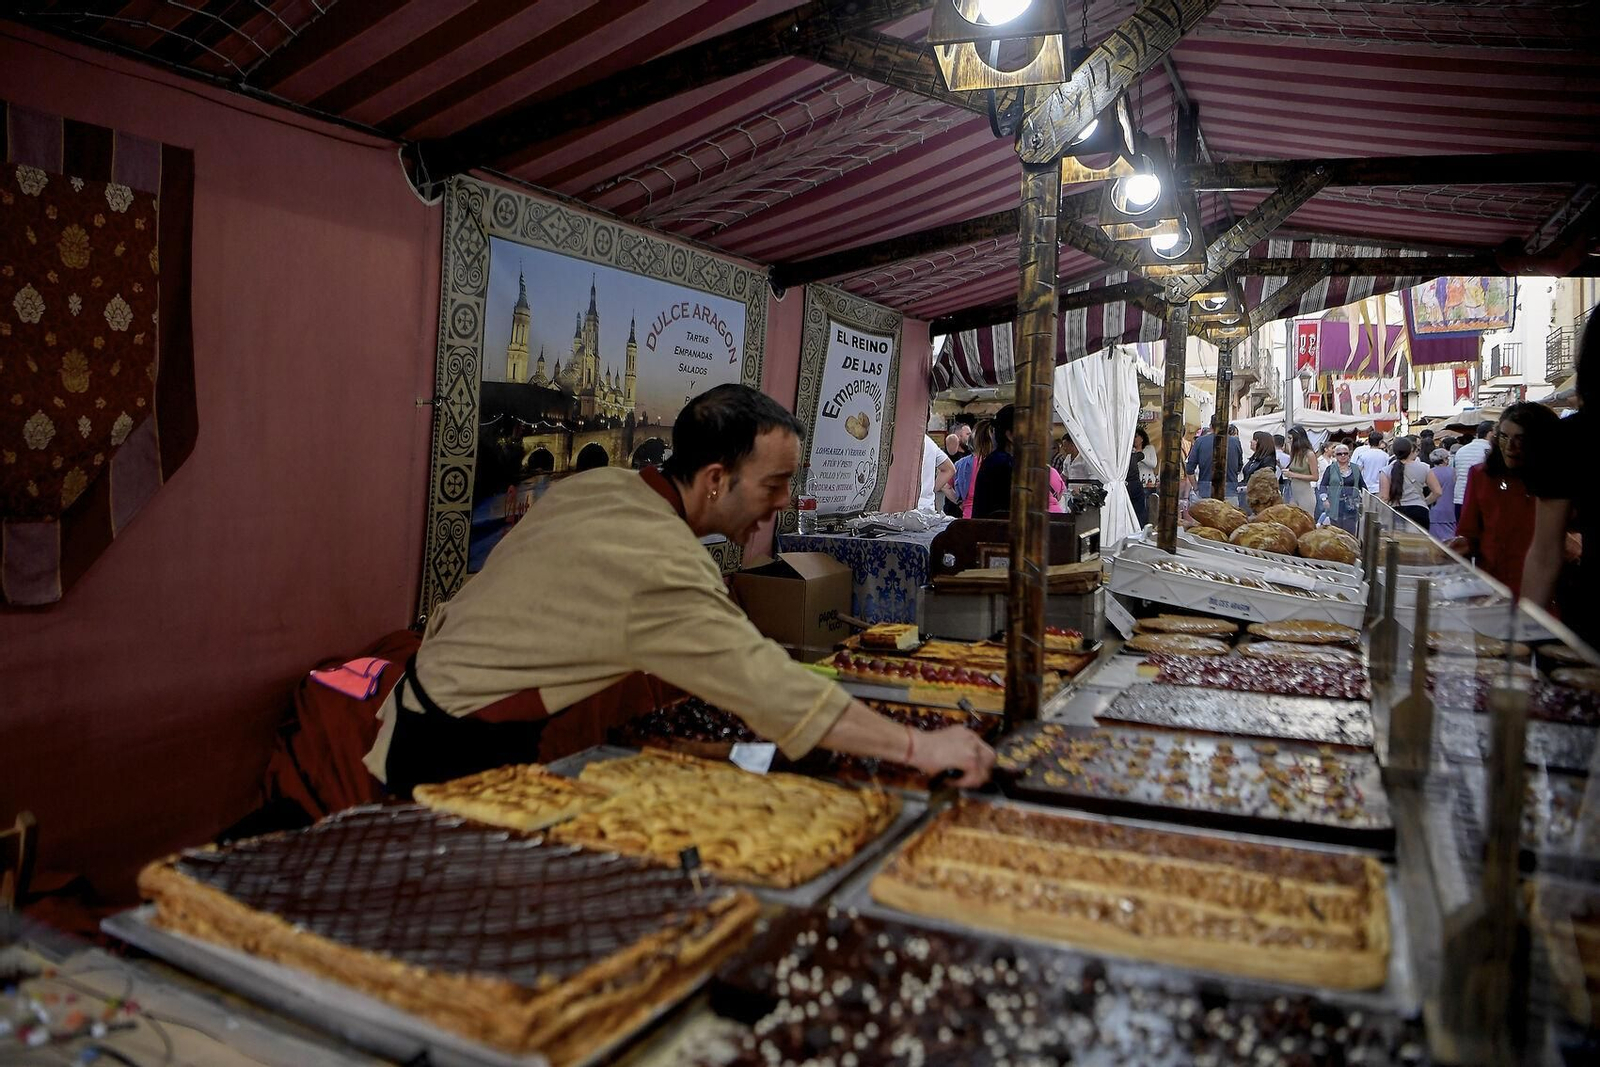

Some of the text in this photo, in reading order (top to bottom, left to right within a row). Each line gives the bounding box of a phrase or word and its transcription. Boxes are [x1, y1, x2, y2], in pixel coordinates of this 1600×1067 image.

[646, 302, 738, 365] DULCE ARAGON
[686, 331, 710, 345] TARTAS
[836, 329, 889, 354] EL REINO
[674, 345, 713, 361] EMPANADAS
[678, 362, 708, 376] SALADOS
[841, 356, 883, 376] DE LAS
[690, 380, 696, 390] Y
[822, 379, 883, 423] Empanadillas
